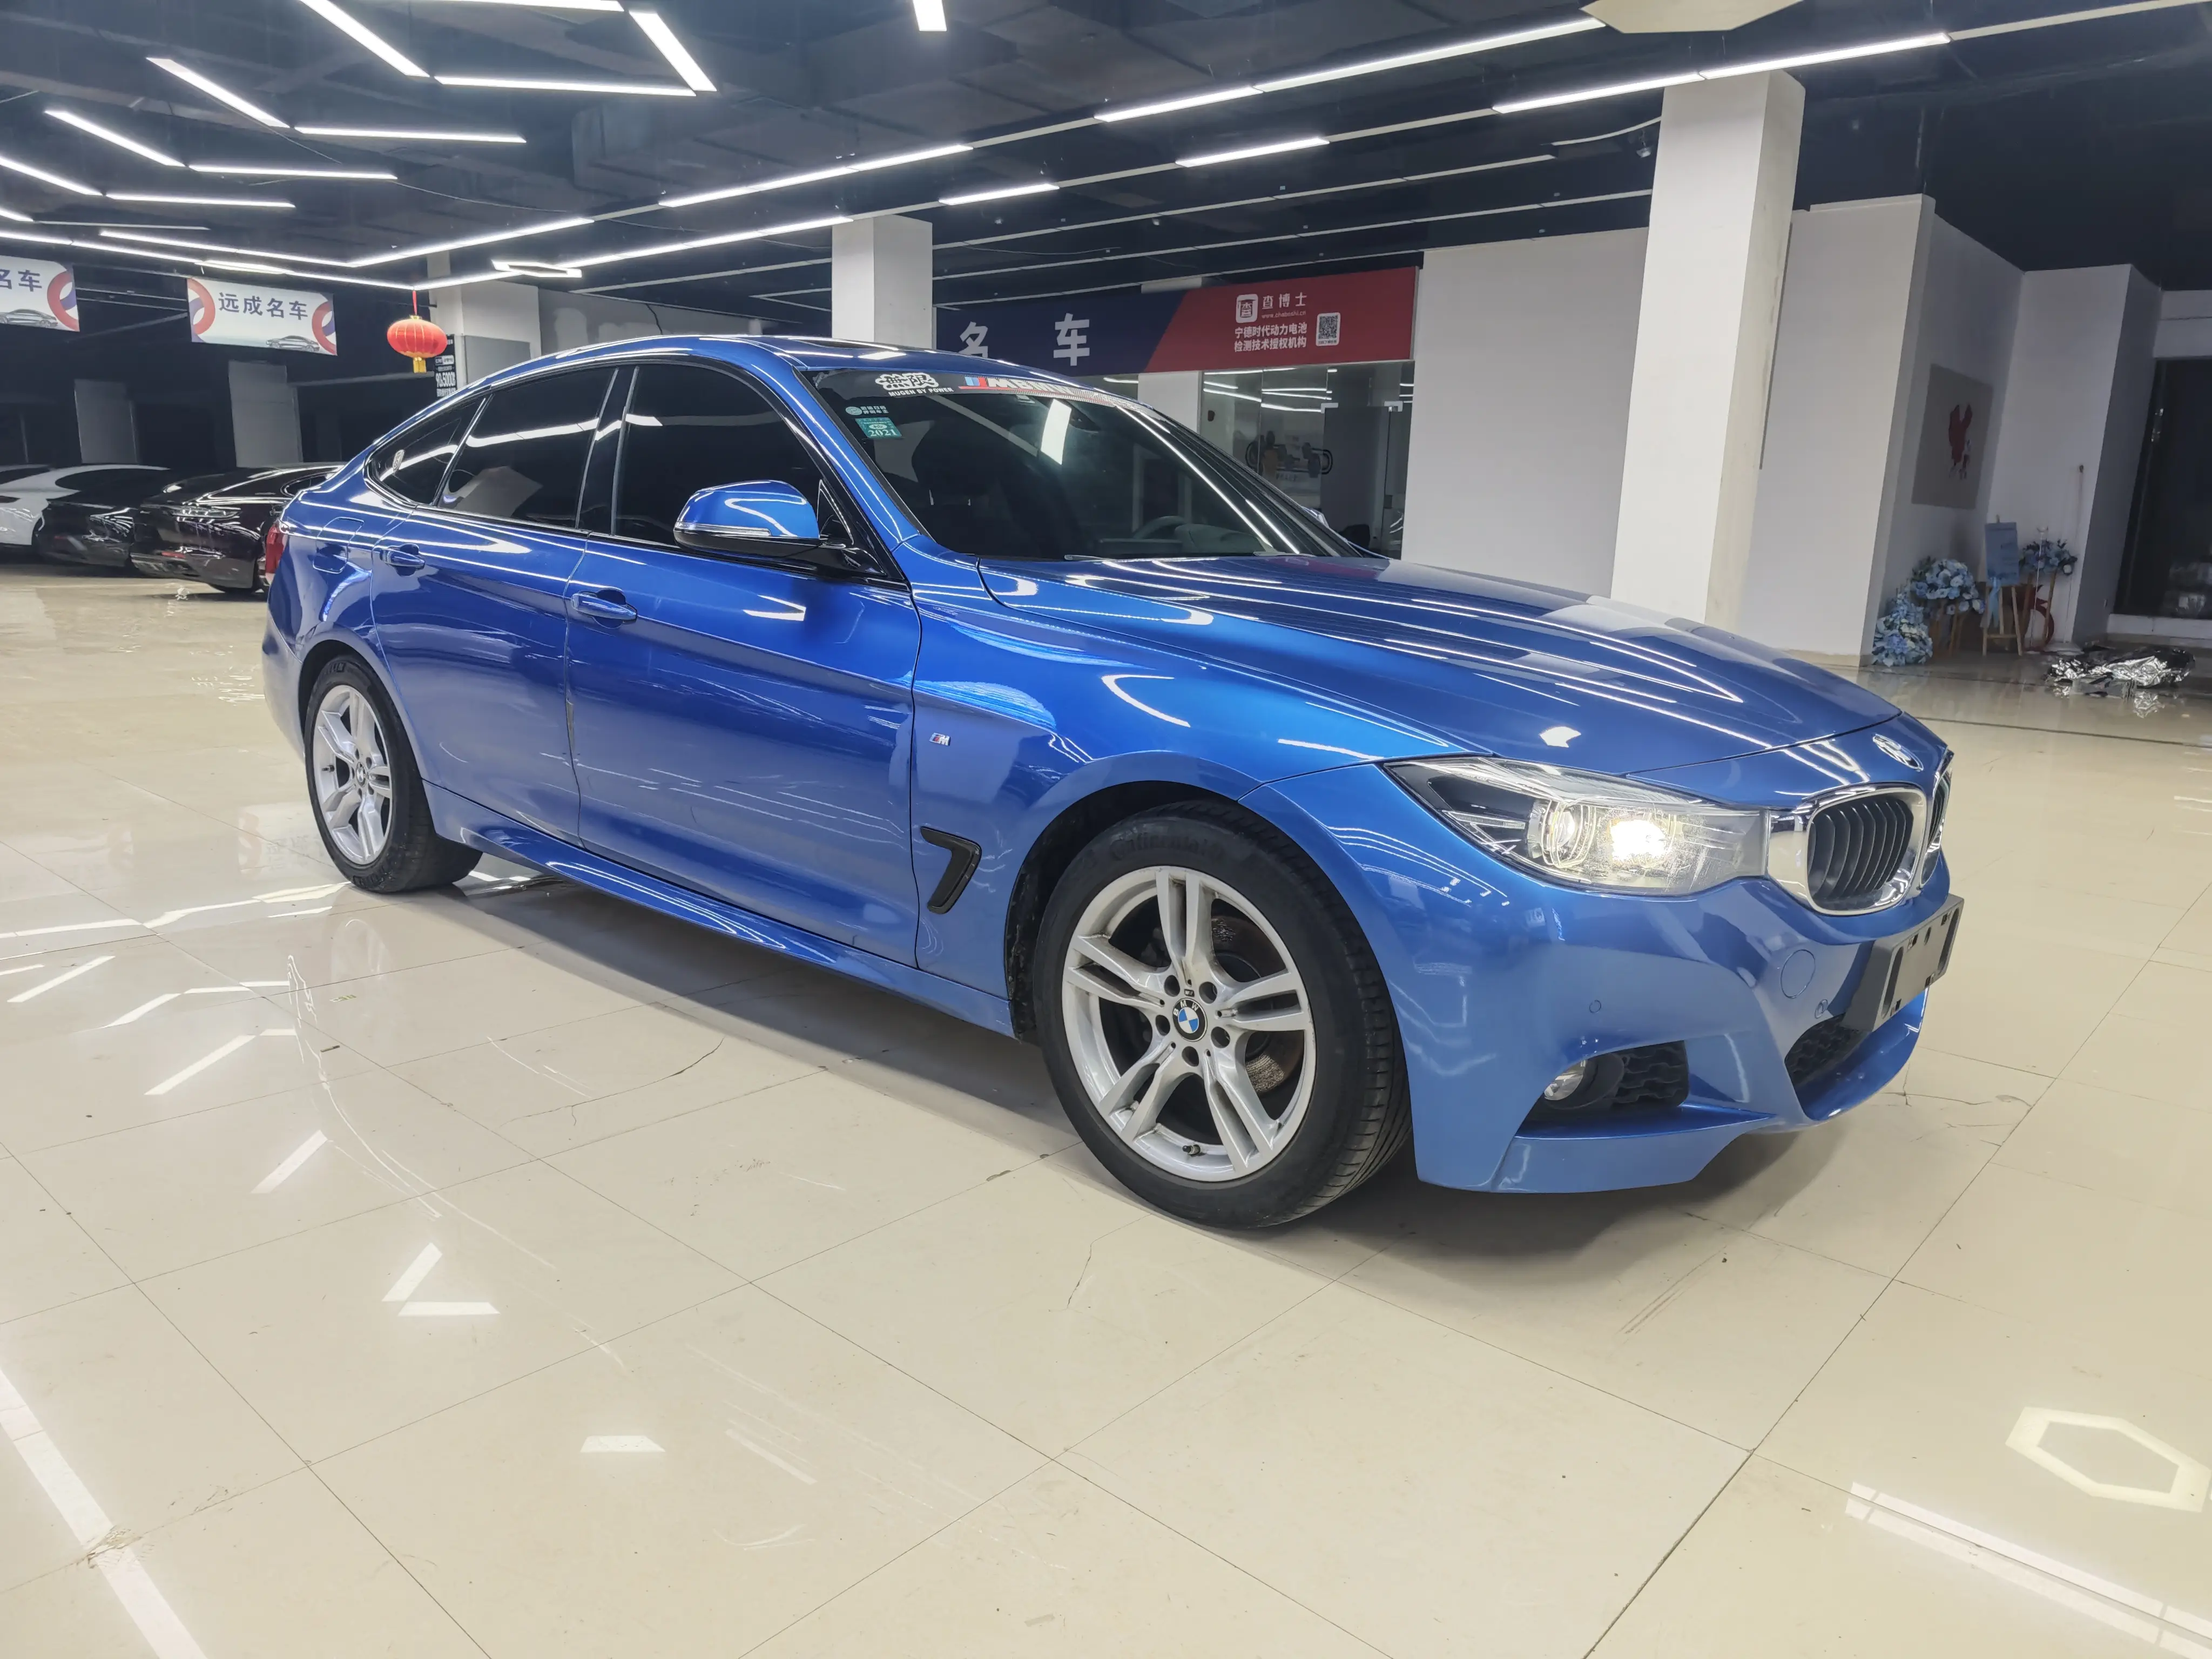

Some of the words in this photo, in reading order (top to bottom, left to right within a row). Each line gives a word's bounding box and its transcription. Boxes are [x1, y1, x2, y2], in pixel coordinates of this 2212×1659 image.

[218, 292, 308, 320] 远成名车
[1262, 292, 1307, 309] 查博士
[1235, 322, 1307, 339] 宁德时代动力电池
[1234, 336, 1307, 352] 检测技术授权机构
[868, 429, 897, 437] 2021
[1174, 1000, 1199, 1016] BMW
